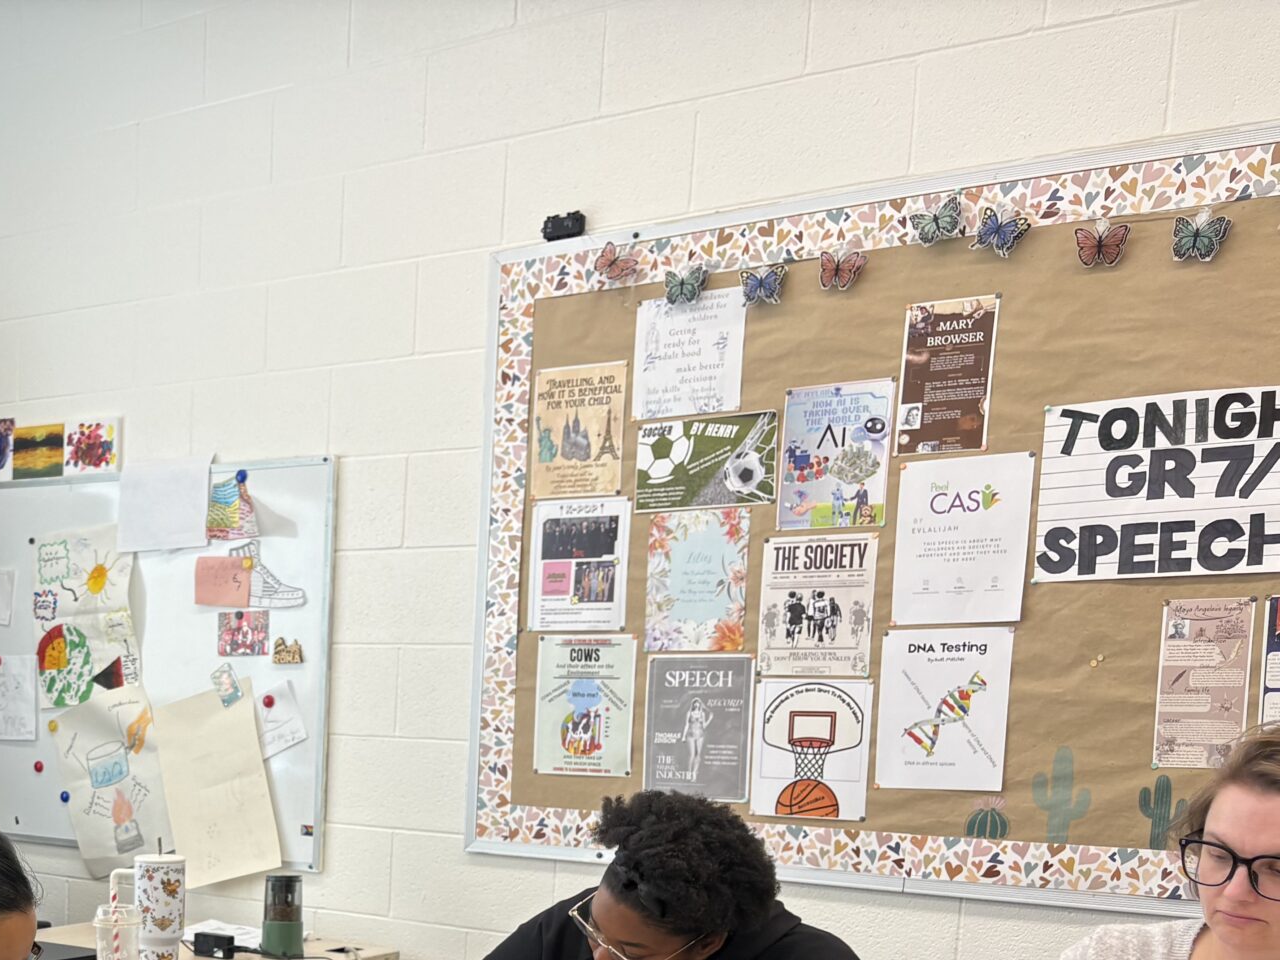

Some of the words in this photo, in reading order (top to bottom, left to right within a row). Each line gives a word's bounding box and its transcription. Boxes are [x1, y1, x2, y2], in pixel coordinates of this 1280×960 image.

[940, 319, 974, 331] MARY
[927, 332, 984, 346] BROWSER
[598, 375, 615, 384] AND
[538, 391, 555, 400] HOW
[558, 390, 566, 398] IT
[568, 389, 575, 397] IS
[578, 385, 622, 397] BENEFICIAL
[547, 400, 561, 410] FOR
[565, 399, 585, 408] YOUR
[588, 396, 611, 406] CHILD
[803, 407, 838, 418] TAKING
[806, 418, 823, 426] THE
[642, 425, 673, 438] SOCCER
[690, 422, 706, 435] BY
[705, 423, 740, 438] HENRY
[817, 424, 846, 449] AI
[930, 480, 949, 492] Peel
[930, 490, 980, 514] CAS
[774, 546, 800, 571] THE
[804, 543, 868, 570] SOCIETY
[1174, 606, 1193, 617] Maya
[570, 648, 600, 662] COWS
[908, 643, 935, 653] DNA
[940, 642, 987, 655] Testing
[665, 671, 733, 687] SPEECH
